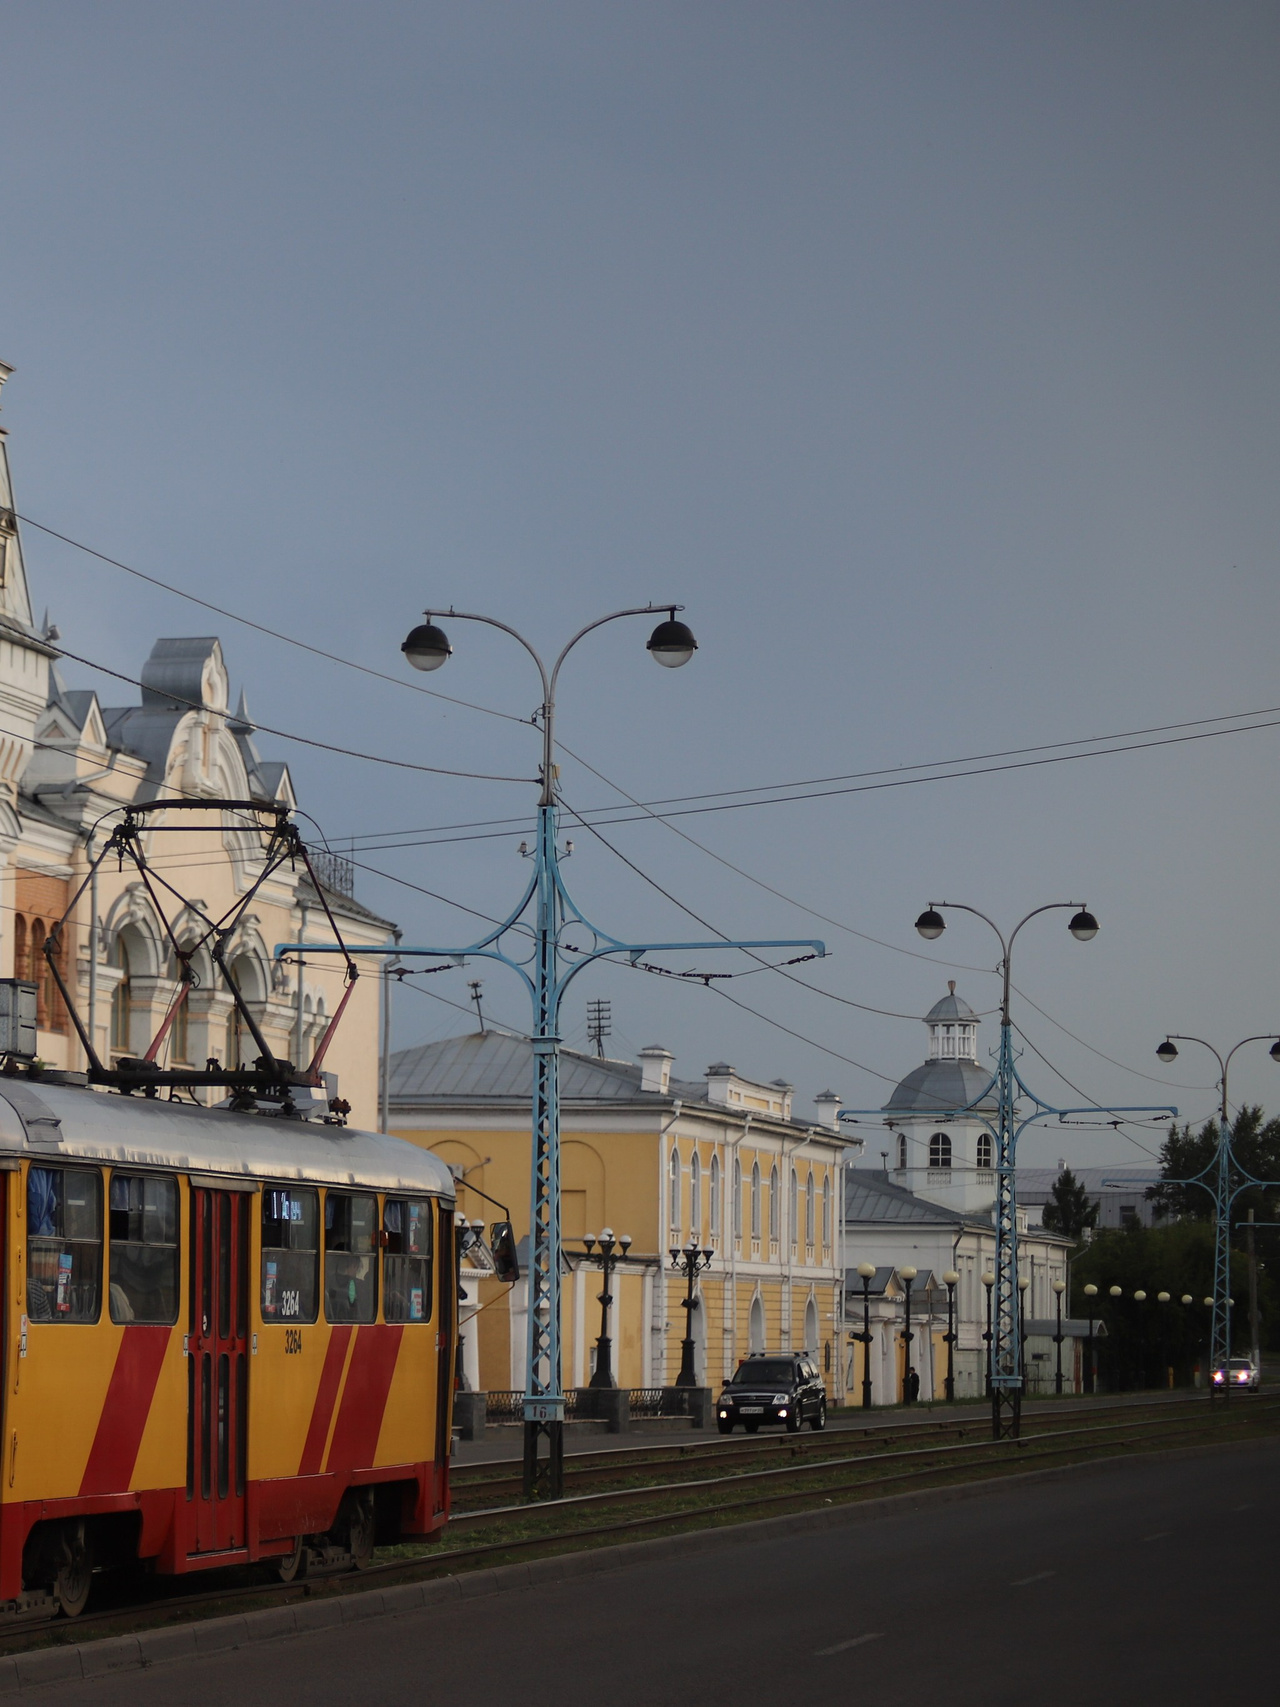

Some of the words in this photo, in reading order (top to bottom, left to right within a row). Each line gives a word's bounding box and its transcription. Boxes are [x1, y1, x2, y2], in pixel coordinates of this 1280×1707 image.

[281, 1290, 300, 1316] 3264
[285, 1329, 302, 1354] 3264
[533, 1405, 547, 1419] 16
